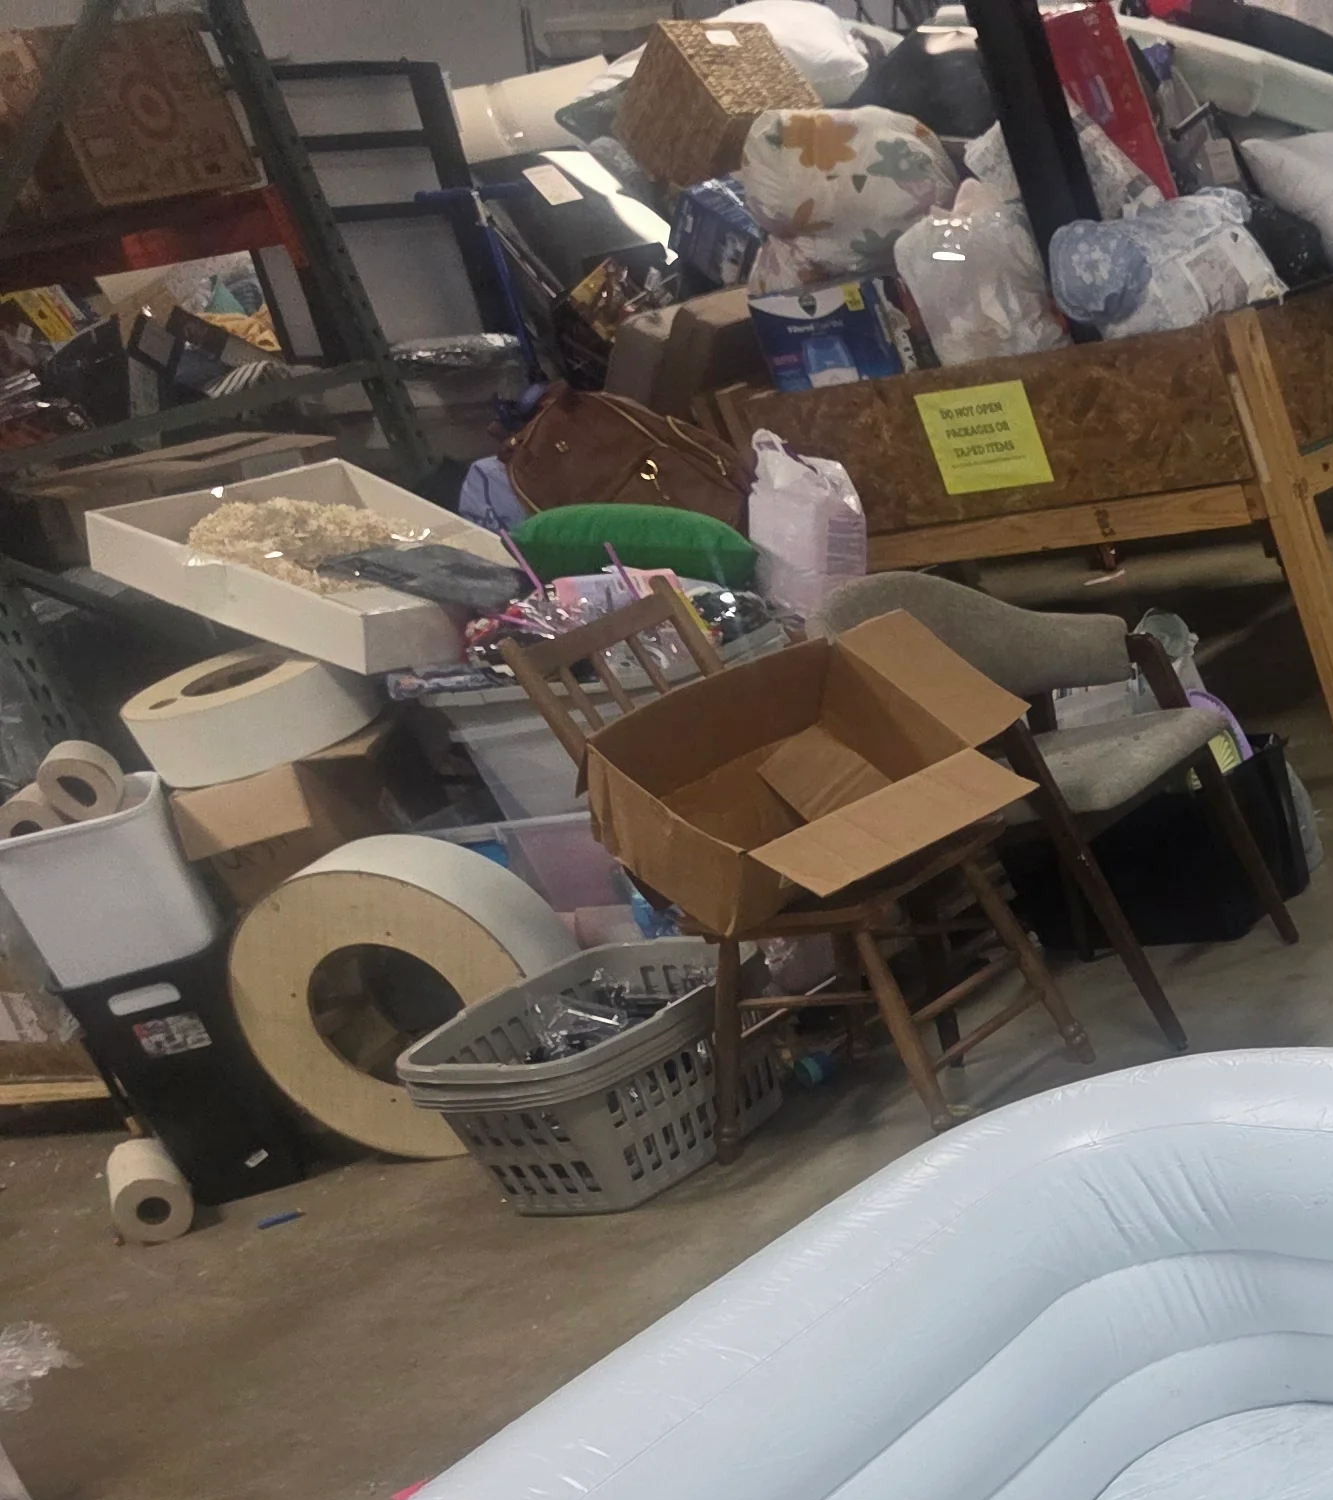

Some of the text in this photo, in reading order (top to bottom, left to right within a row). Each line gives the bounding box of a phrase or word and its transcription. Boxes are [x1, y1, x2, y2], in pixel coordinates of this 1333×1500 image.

[939, 401, 1003, 421] DO NOT OPEN
[945, 420, 1010, 440] PACKAGES OR
[953, 439, 1016, 459] TAPED ITEMS
